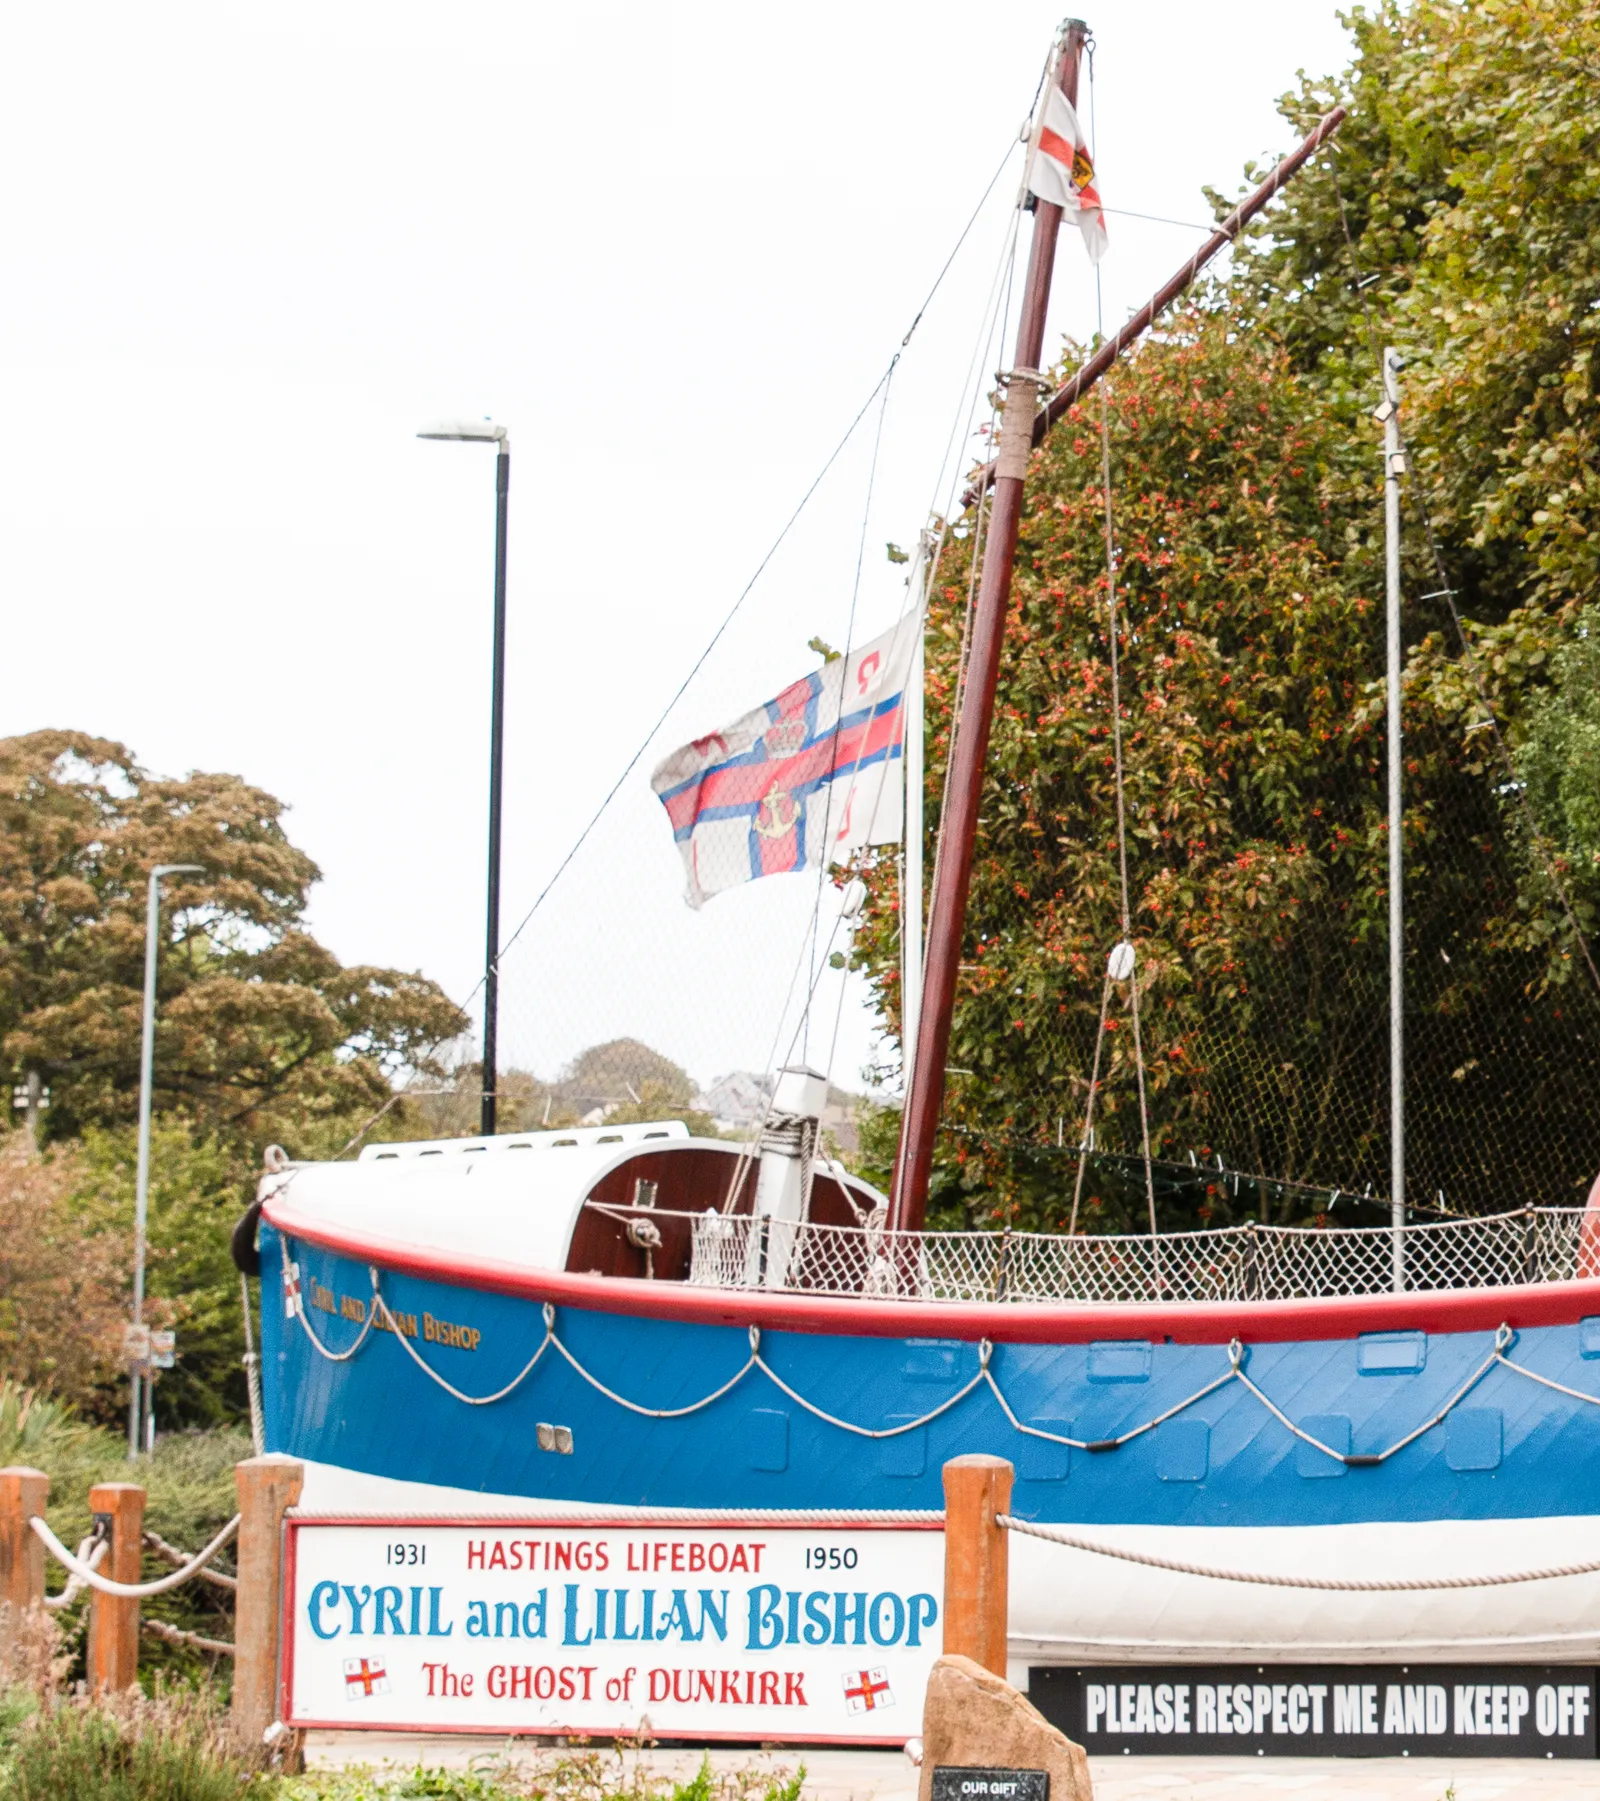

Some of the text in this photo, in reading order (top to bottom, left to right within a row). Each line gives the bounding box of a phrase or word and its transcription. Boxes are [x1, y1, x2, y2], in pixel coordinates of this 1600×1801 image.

[422, 1311, 482, 1351] BISHOP
[386, 1540, 859, 1573] 1931 HASTINGS LIFEBOAT 1950
[305, 1579, 939, 1652] CYRIL and LILIAN BISHOP
[422, 1662, 809, 1706] The GHOST of DUNKIRK
[1085, 1684, 1591, 1737] PLEASE RESPECT ME AND KEEP OFF
[961, 1781, 1018, 1795] OUR GIFT
